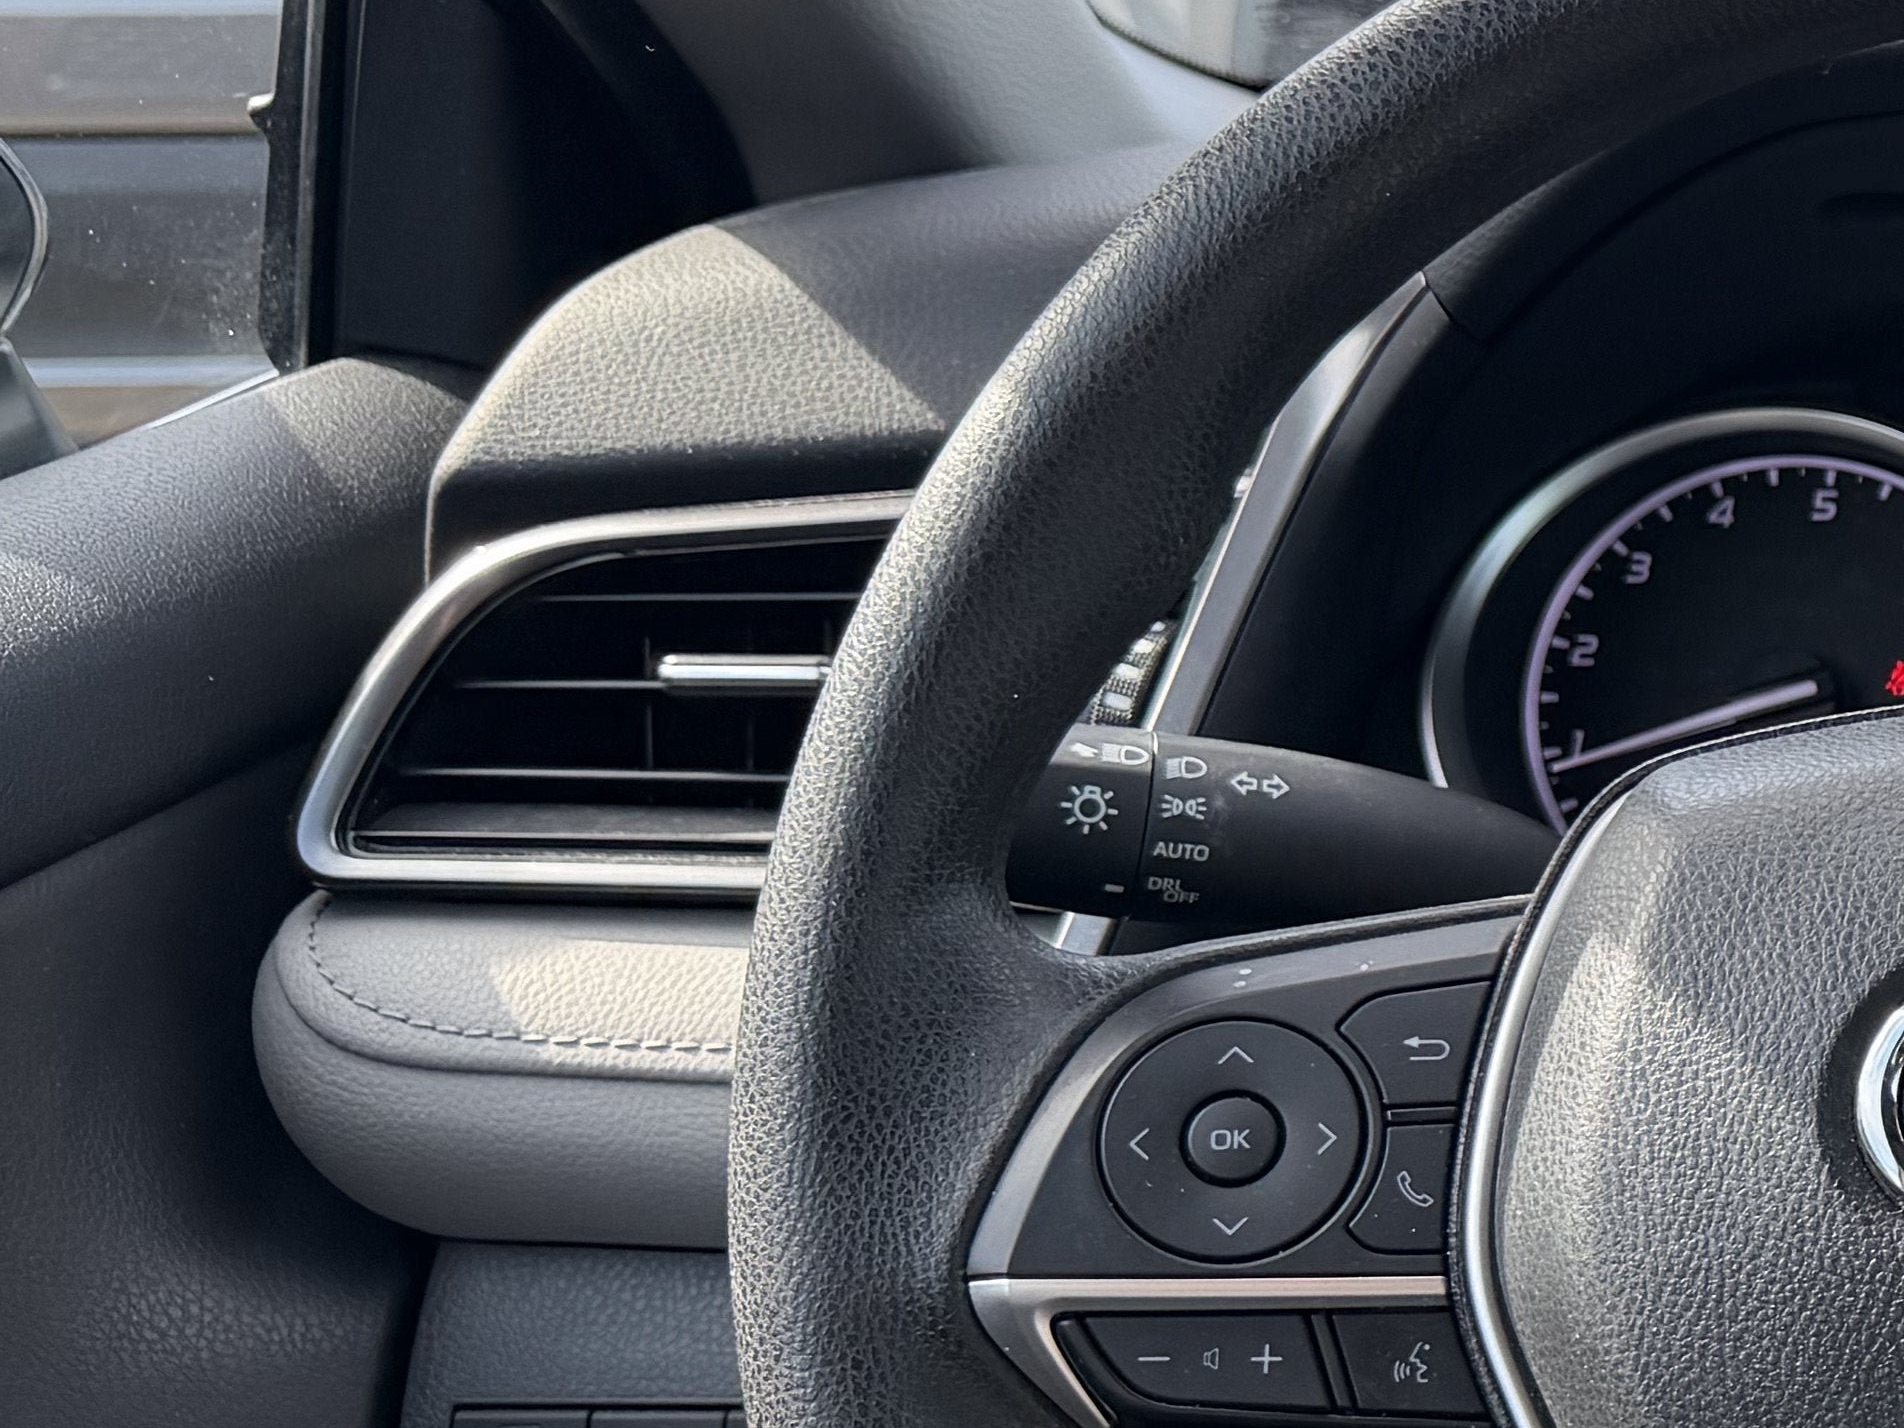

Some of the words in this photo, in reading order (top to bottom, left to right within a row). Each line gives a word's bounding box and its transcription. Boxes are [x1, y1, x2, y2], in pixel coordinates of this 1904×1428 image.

[1706, 495, 1735, 529] 4
[1812, 489, 1839, 522] 5
[1624, 551, 1653, 585] 3
[1568, 634, 1601, 668] 2
[1152, 841, 1211, 864] AUTO
[1147, 875, 1184, 893] DRL
[1162, 889, 1200, 905] OFF
[1209, 1128, 1252, 1151] OK
